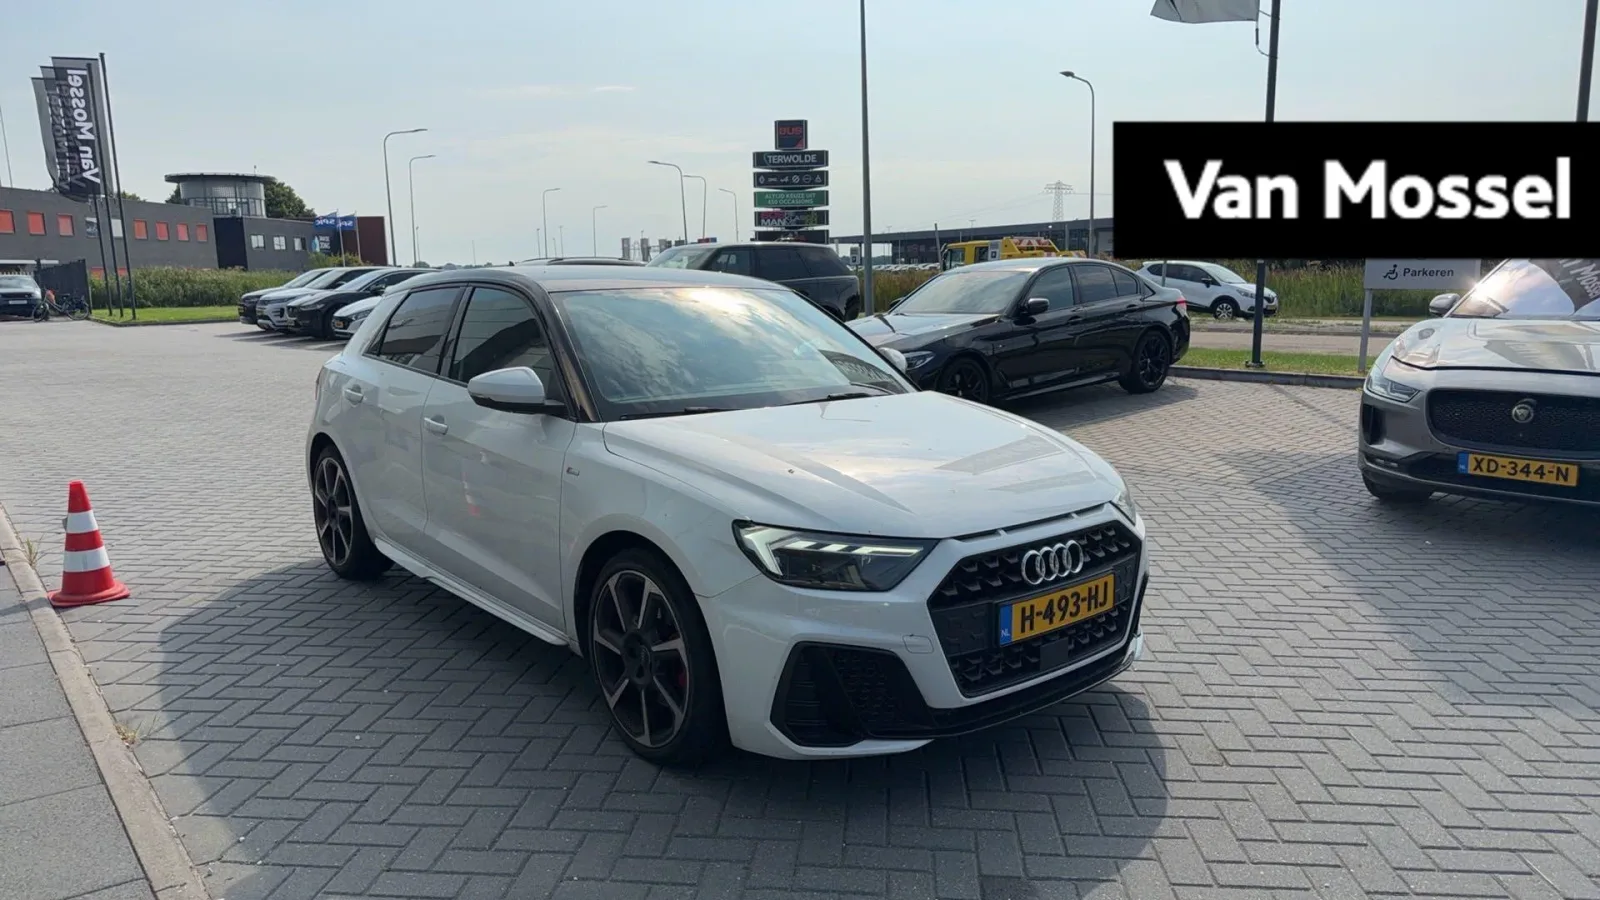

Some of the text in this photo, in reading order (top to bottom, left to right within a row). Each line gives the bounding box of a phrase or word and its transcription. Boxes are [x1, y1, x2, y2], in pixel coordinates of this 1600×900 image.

[767, 154, 817, 164] TERWOLDE
[1403, 267, 1454, 277] Parkeren
[1473, 457, 1569, 482] XD-344-N
[1021, 581, 1108, 633] H-493-HJ
[1001, 629, 1010, 637] NL
